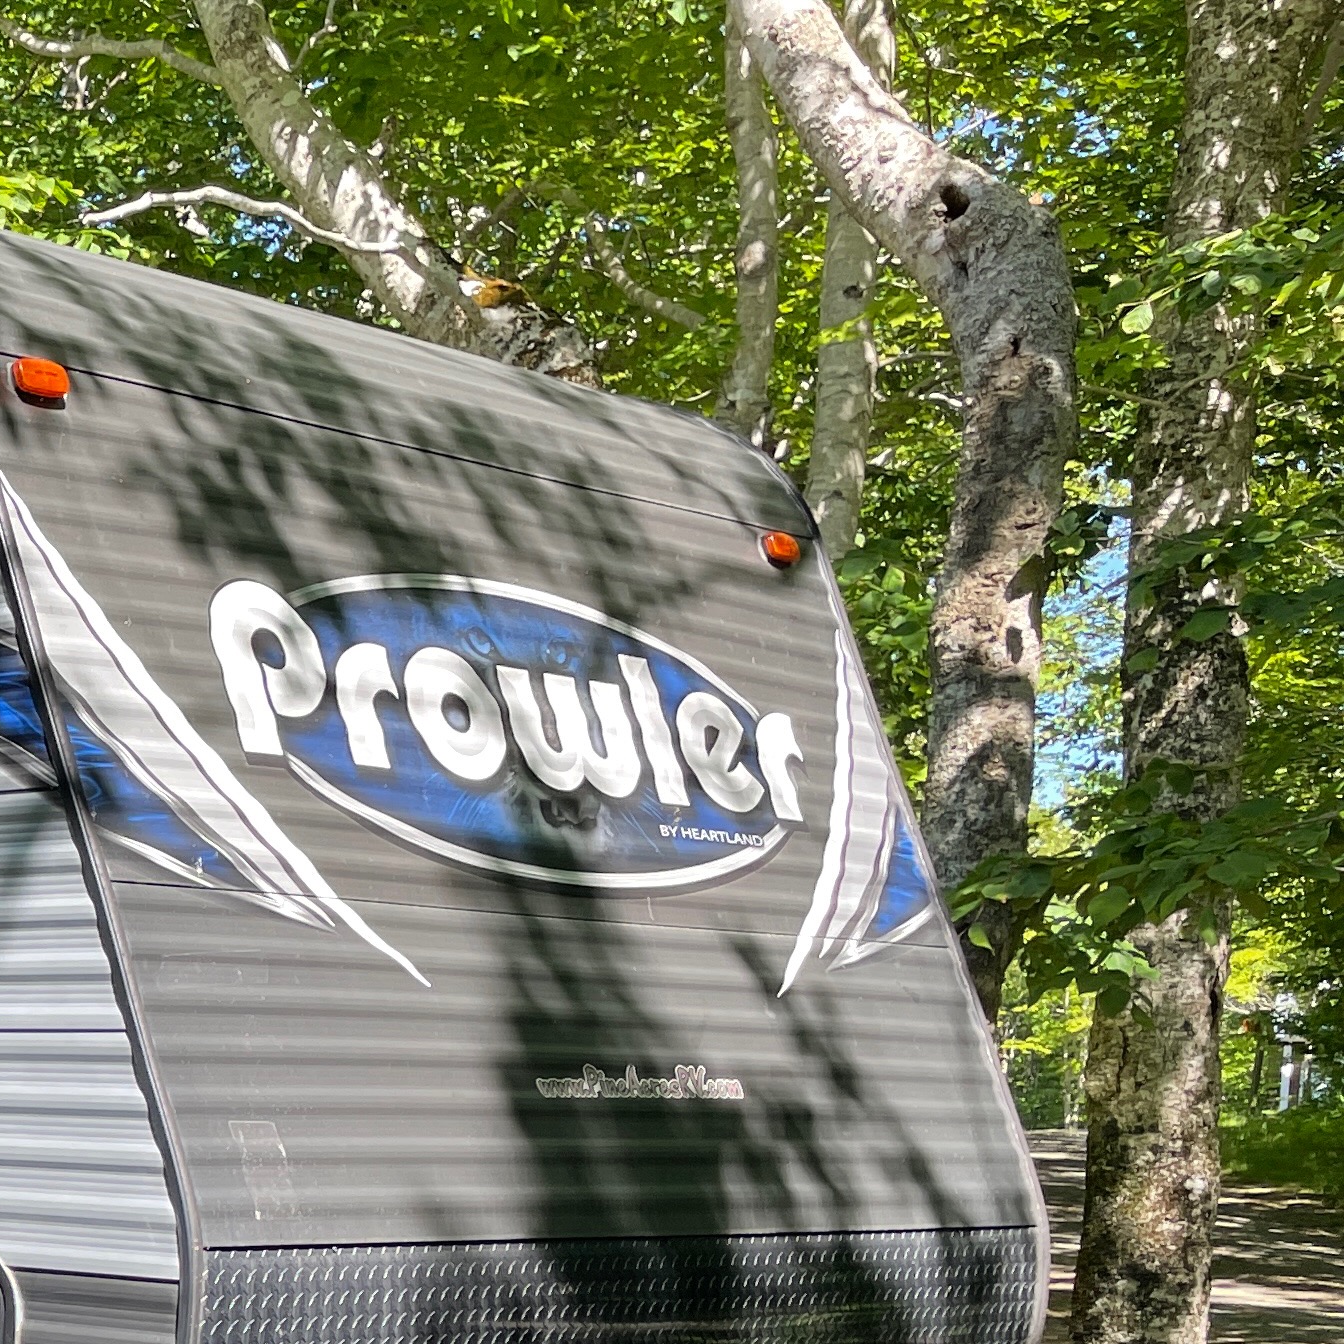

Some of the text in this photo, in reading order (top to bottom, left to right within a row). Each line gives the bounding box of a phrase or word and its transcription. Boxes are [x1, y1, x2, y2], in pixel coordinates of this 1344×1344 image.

[210, 579, 805, 822] Prowler
[659, 824, 764, 847] BY HEARTLAND
[536, 1063, 745, 1099] www.PineAcresRV.com
